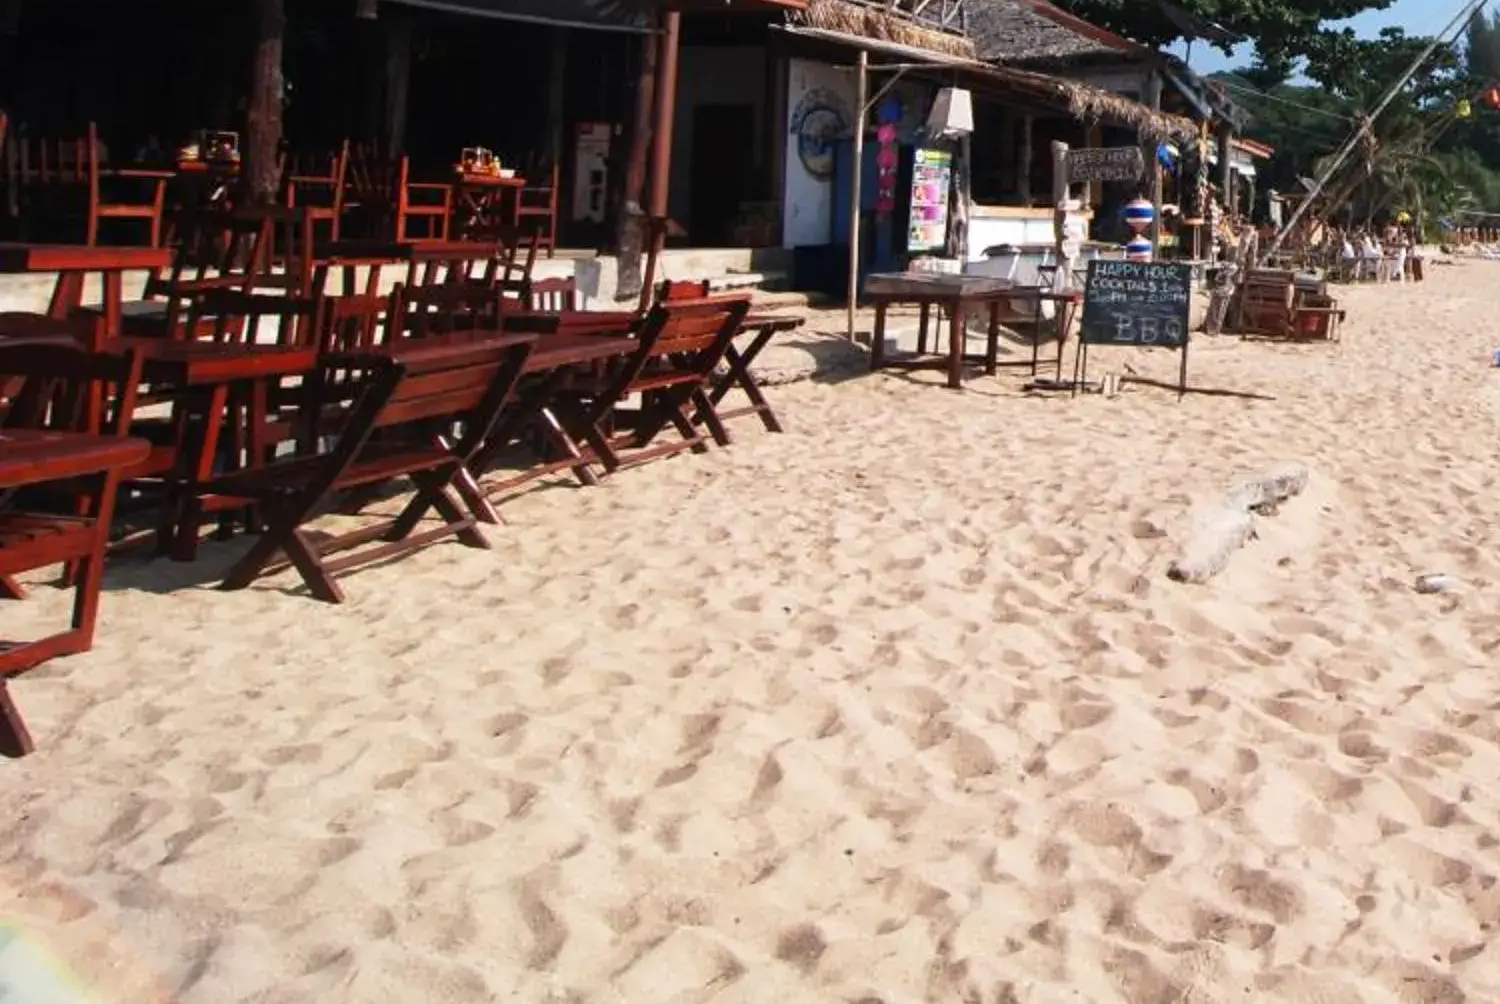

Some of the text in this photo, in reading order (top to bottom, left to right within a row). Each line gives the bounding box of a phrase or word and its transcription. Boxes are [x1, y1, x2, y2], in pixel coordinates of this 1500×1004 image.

[1095, 263, 1182, 281] HAPPY HOUR
[1091, 277, 1157, 293] COCKTAILS
[1112, 312, 1183, 343] BBQ
